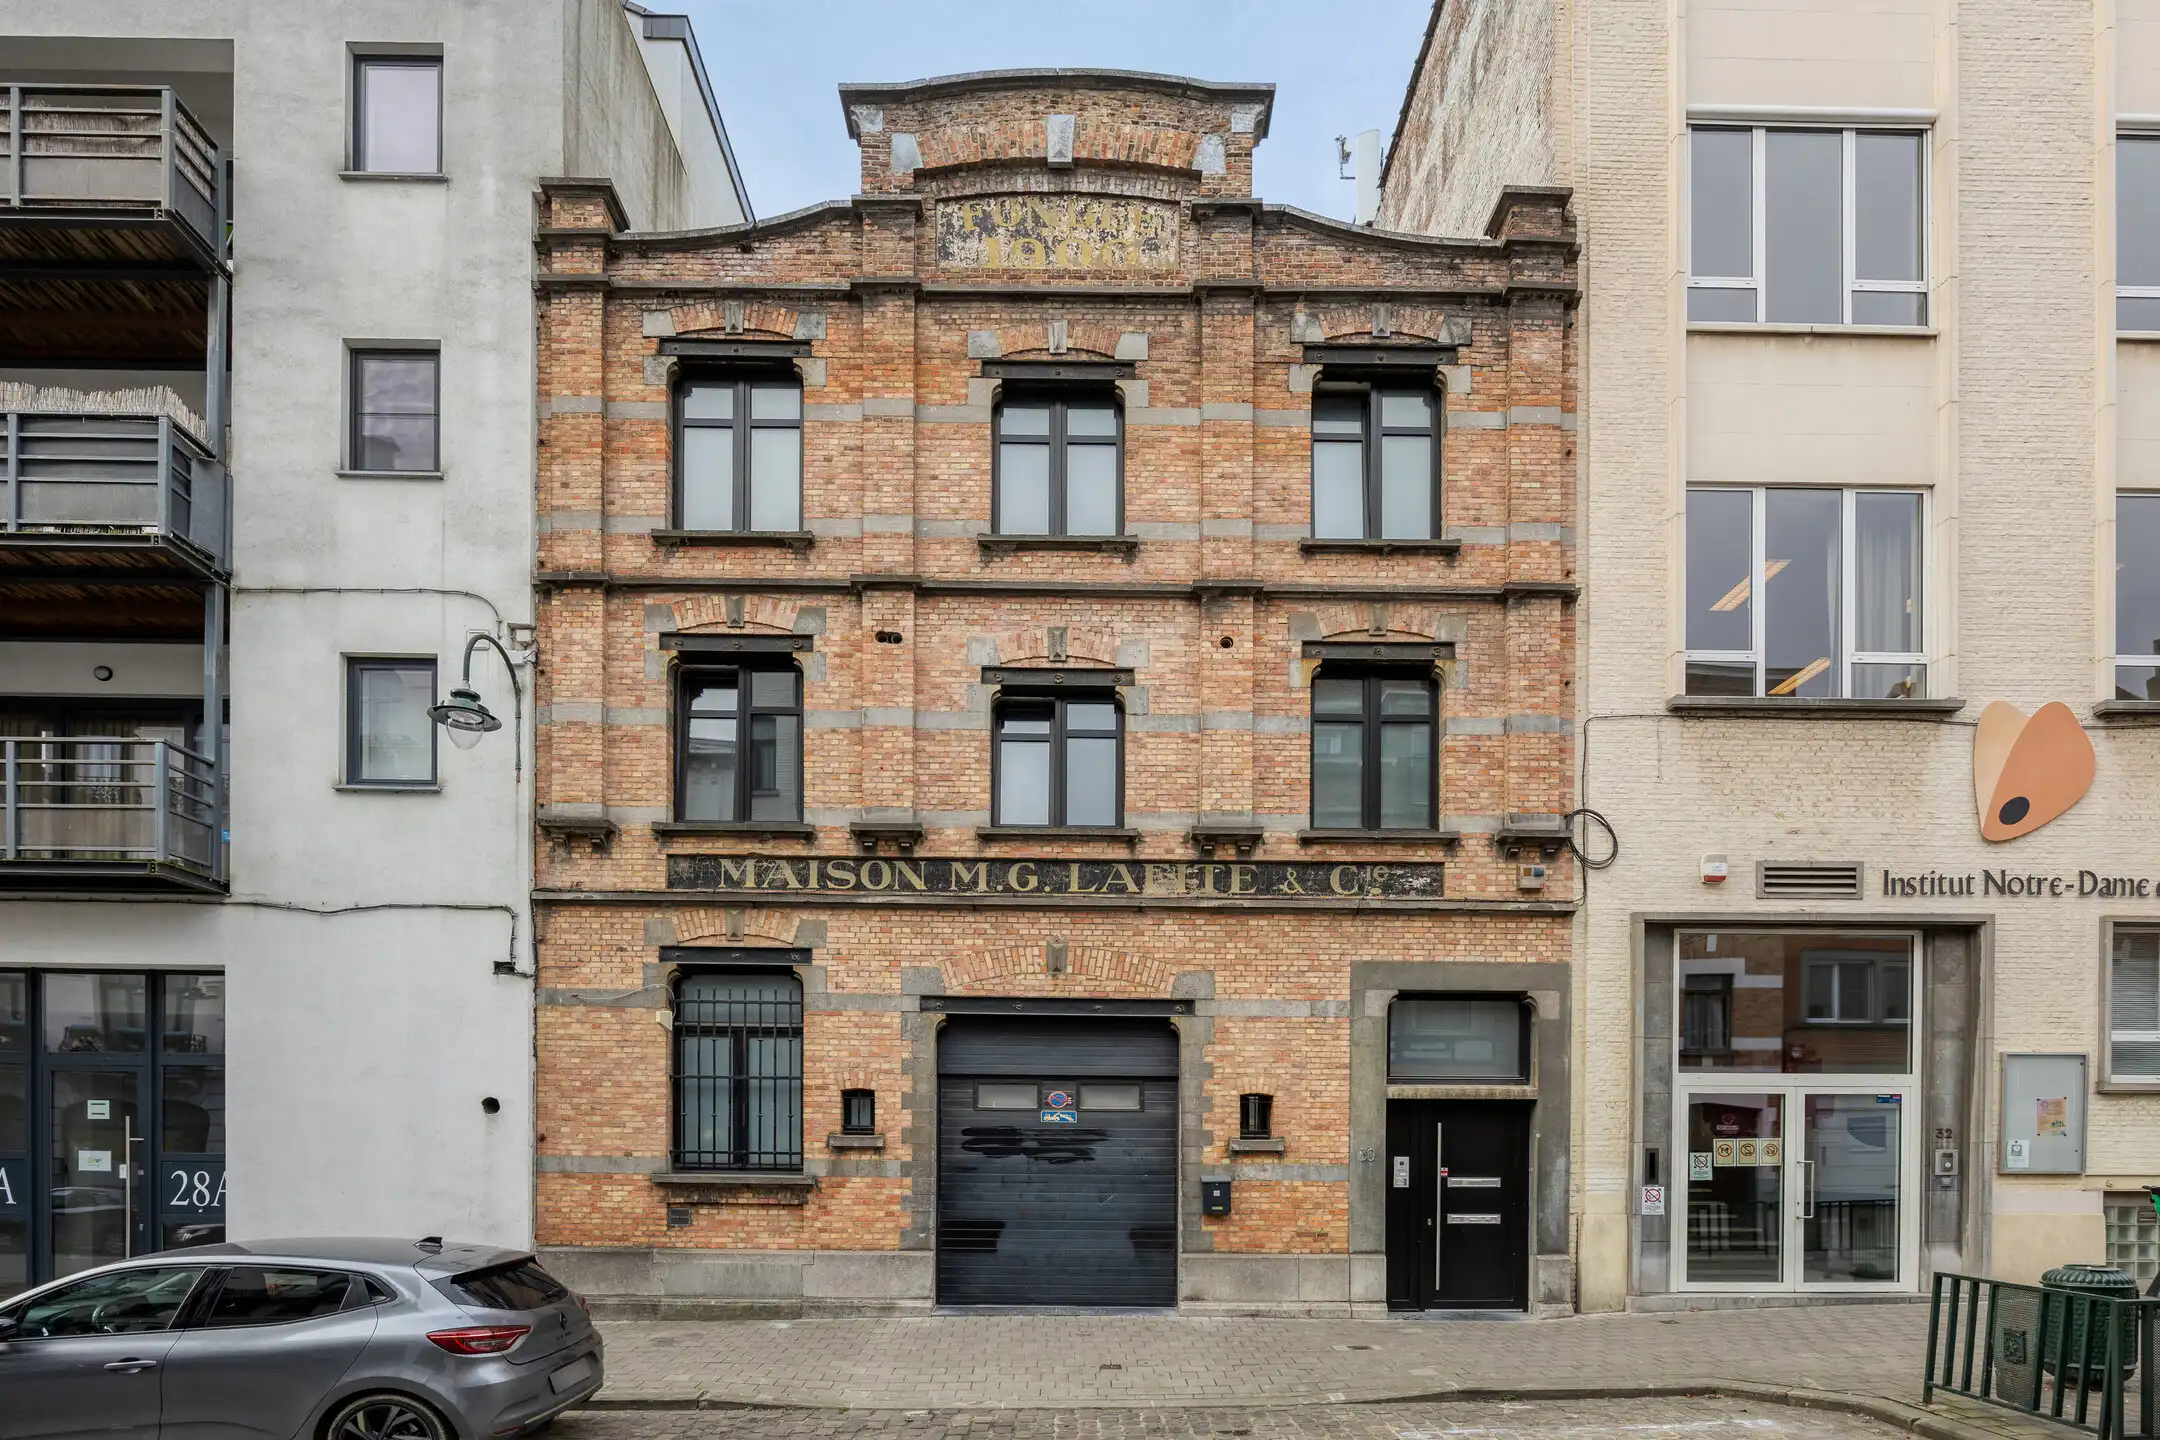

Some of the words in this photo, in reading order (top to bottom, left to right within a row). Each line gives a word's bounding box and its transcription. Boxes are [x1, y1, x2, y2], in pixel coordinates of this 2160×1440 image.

[718, 858, 929, 890] MAISON
[1279, 867, 1306, 894] &
[1883, 869, 1976, 897] Institut
[1982, 869, 2150, 897] Notre-Dame
[1935, 1128, 1953, 1139] 32
